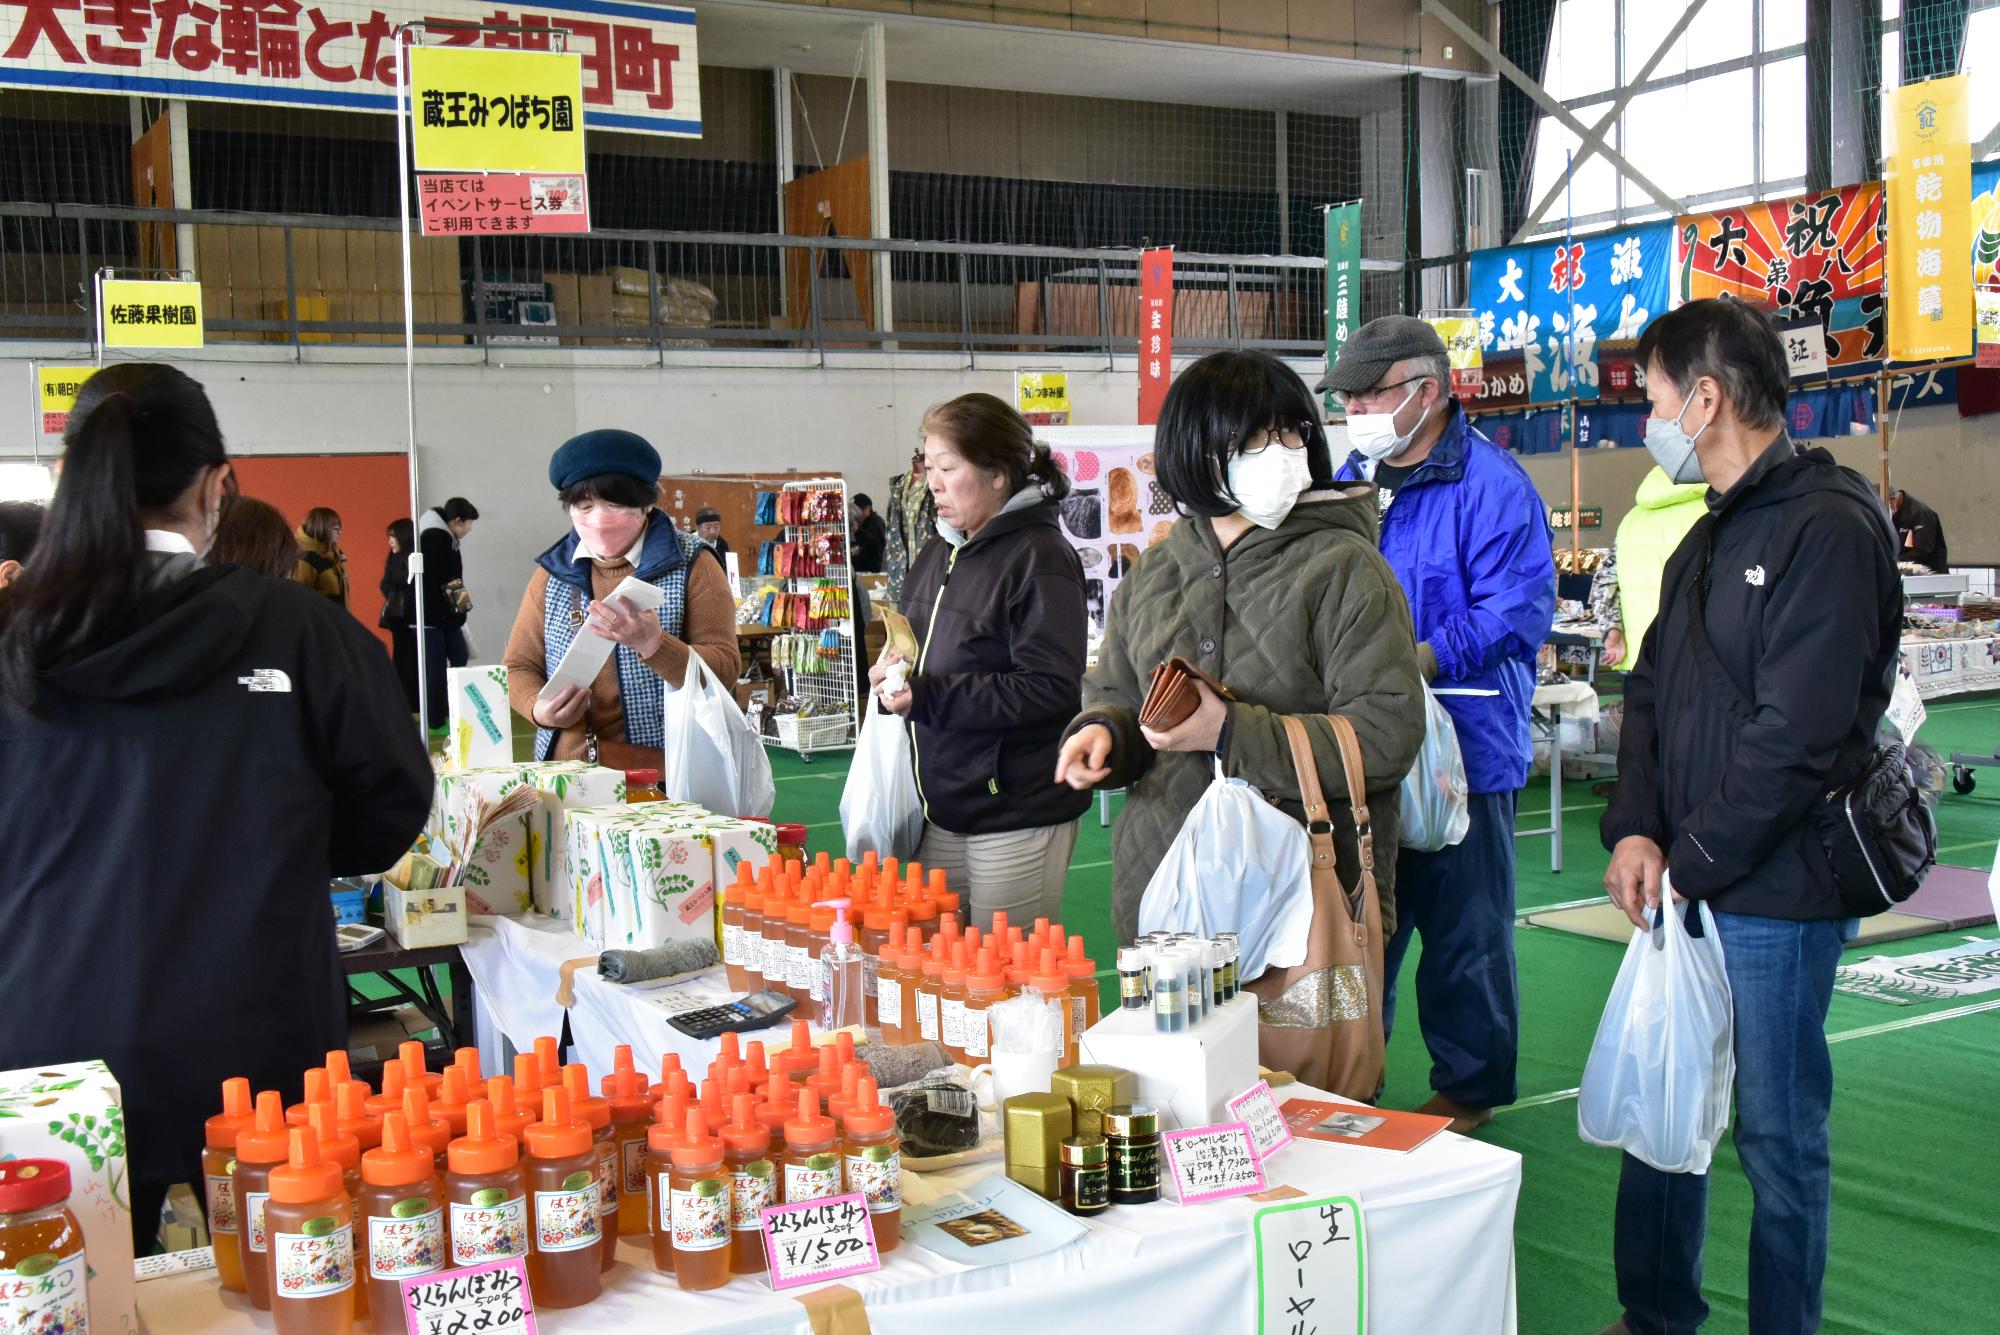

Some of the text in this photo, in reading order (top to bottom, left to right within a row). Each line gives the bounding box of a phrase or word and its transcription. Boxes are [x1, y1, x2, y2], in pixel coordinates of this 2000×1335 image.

[422, 89, 574, 132] 蔵王みつばち園
[424, 179, 486, 194] 当店では
[426, 197, 564, 212] イベントサービス券
[429, 216, 534, 232] ご利用できます
[111, 304, 196, 325] 佐藤果樹園
